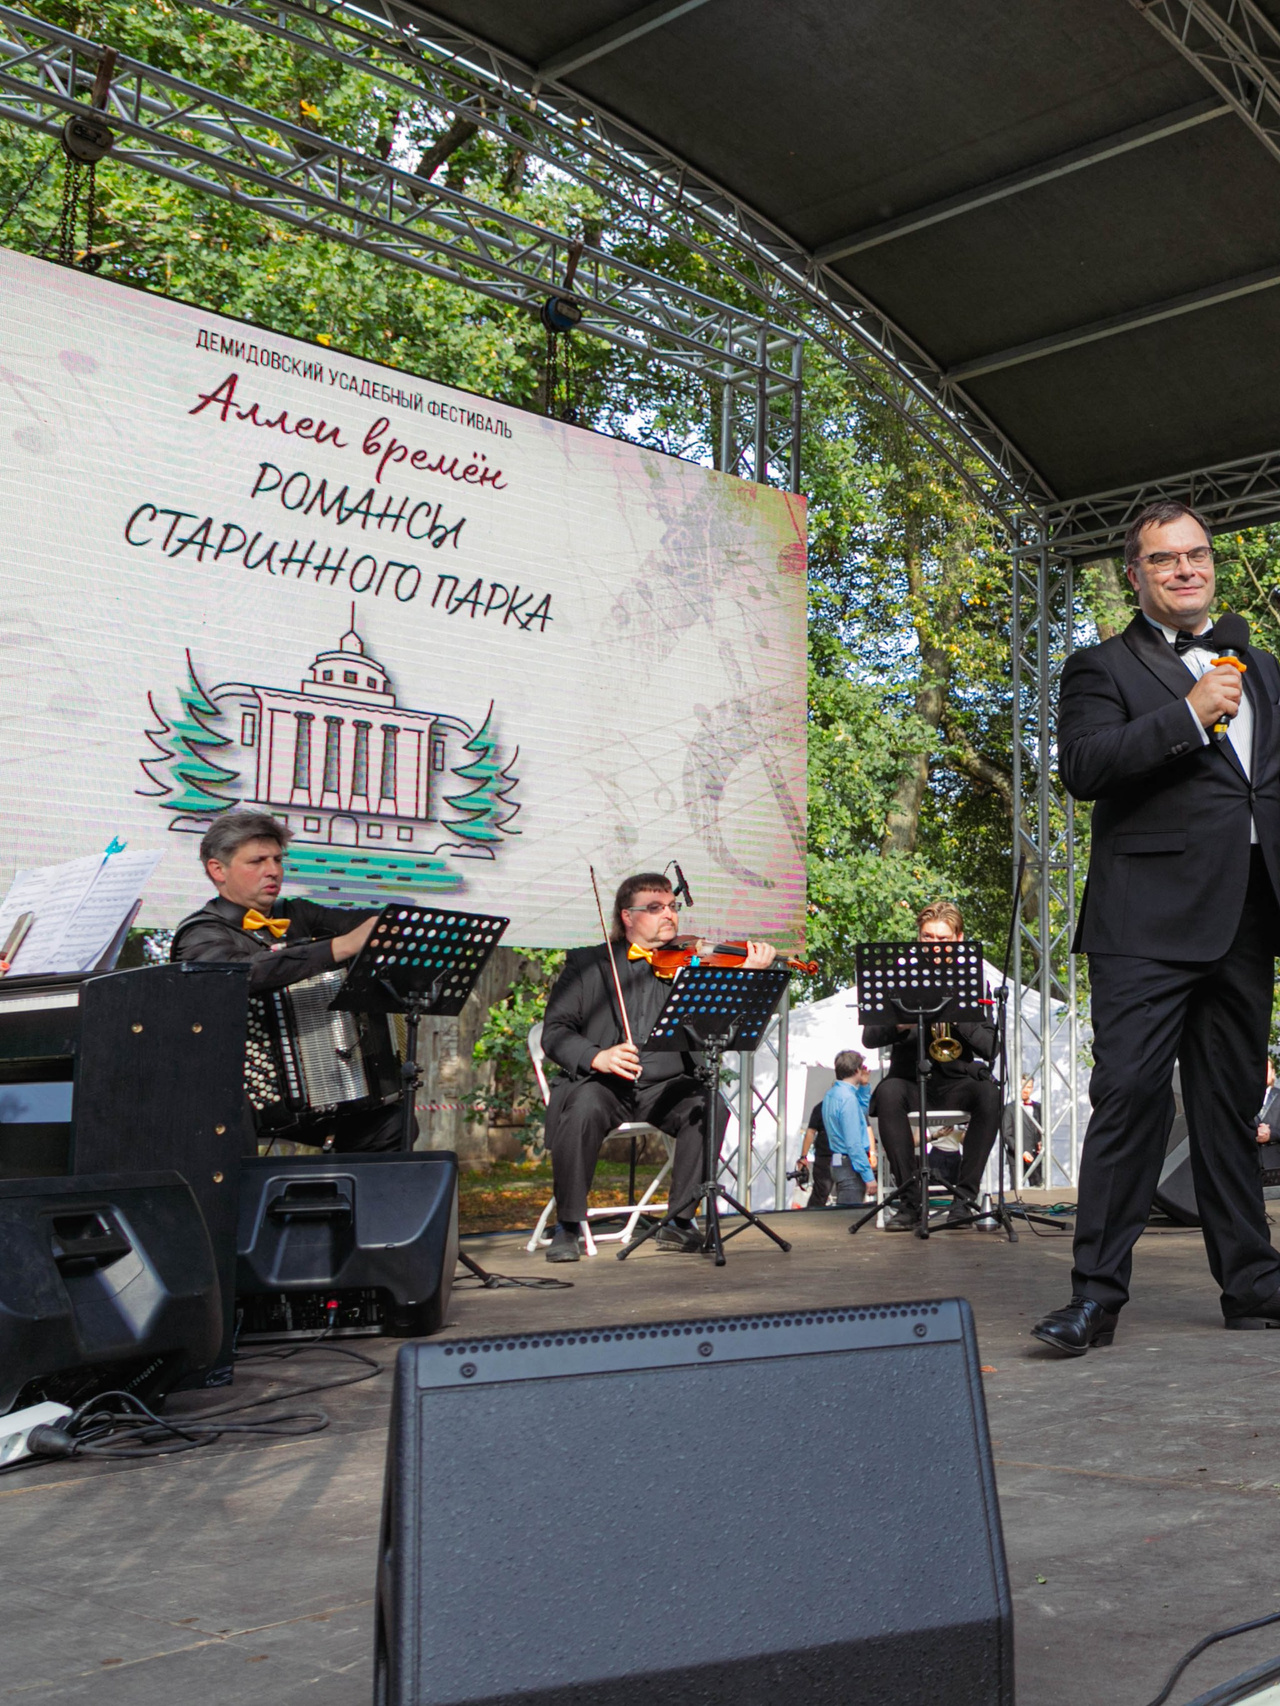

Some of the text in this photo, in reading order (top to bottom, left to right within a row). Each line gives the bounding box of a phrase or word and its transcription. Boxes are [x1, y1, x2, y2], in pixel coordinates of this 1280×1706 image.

[188, 372, 509, 490] Аллеи времён
[195, 328, 513, 439] ДЕМИДОВСКИЙ УСАДЕБНЫЙ ФЕСТИВАЛЬ
[250, 462, 467, 550] РОМАНСЫ
[124, 503, 555, 632] СТАРИННОГО ПАРКА
